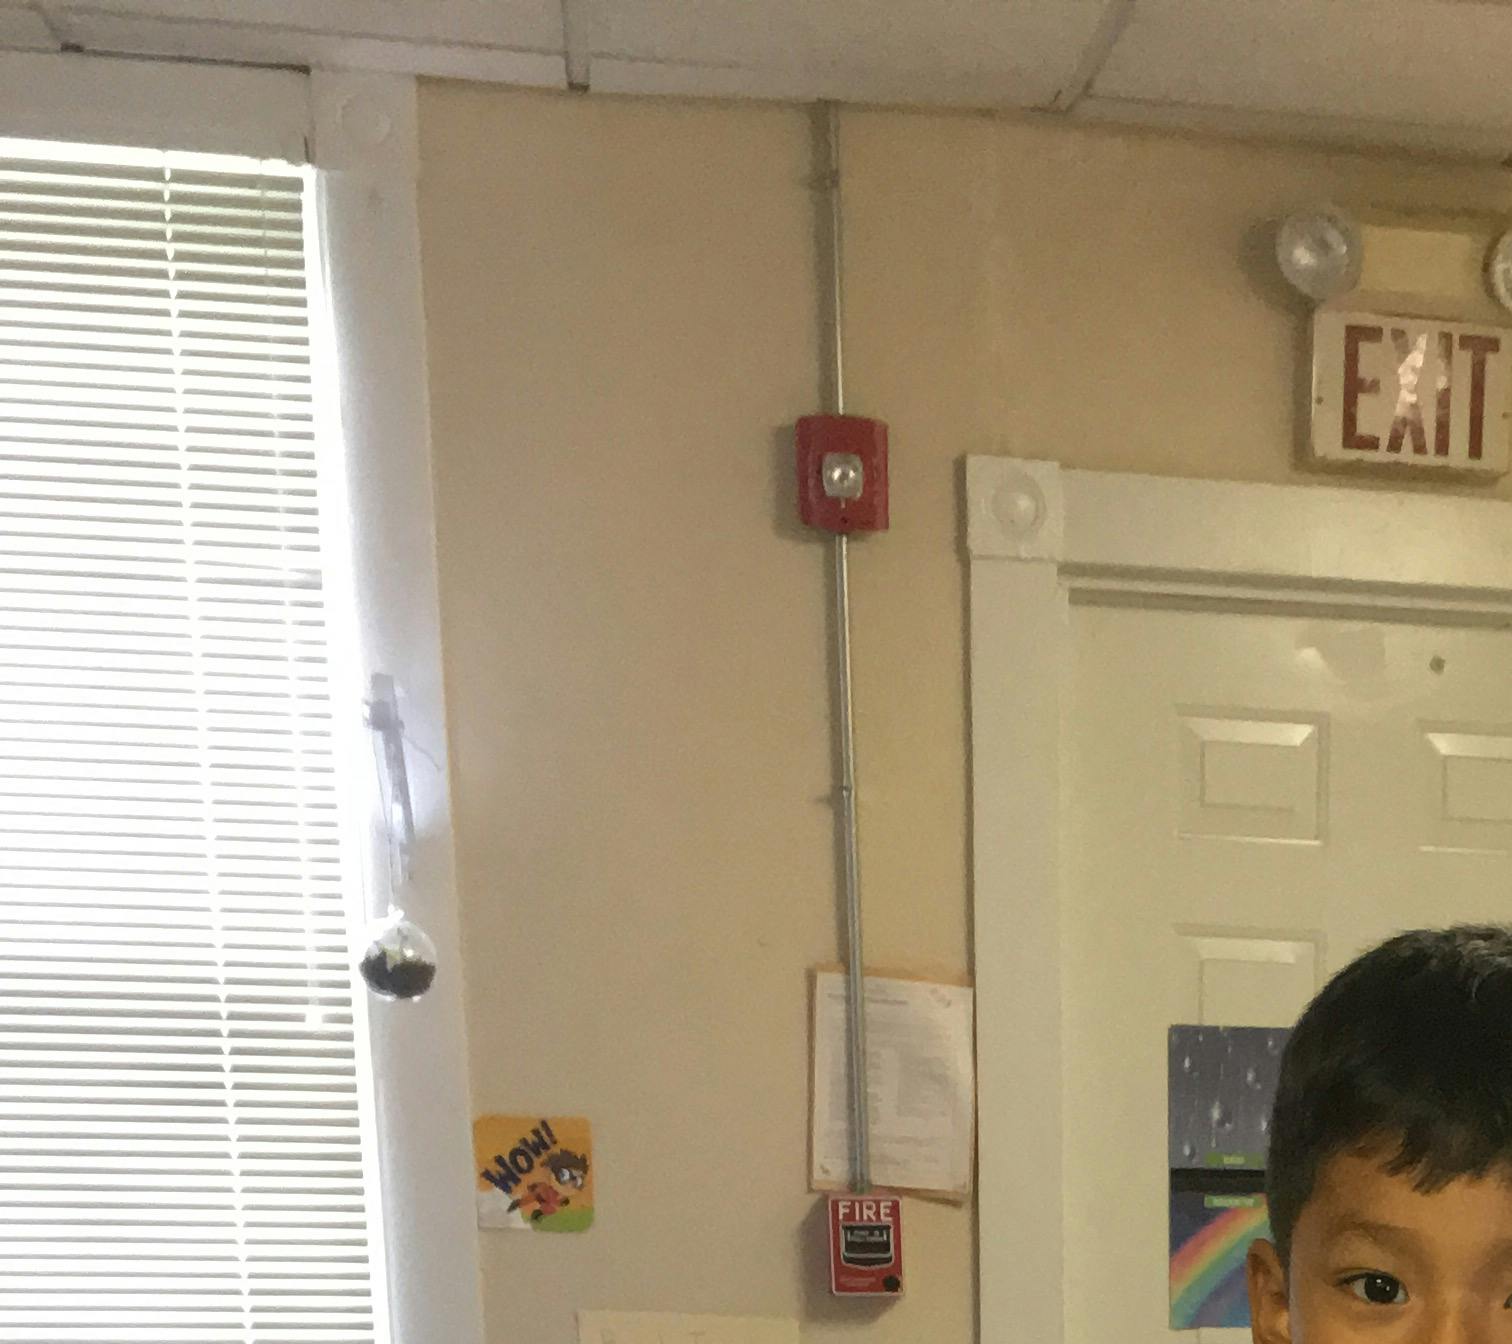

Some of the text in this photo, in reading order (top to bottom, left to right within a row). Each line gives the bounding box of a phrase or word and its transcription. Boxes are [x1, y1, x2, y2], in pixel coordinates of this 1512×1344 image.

[1342, 325, 1500, 460] EXIT
[480, 1120, 557, 1194] WOW!
[838, 1201, 893, 1221] FIRE
